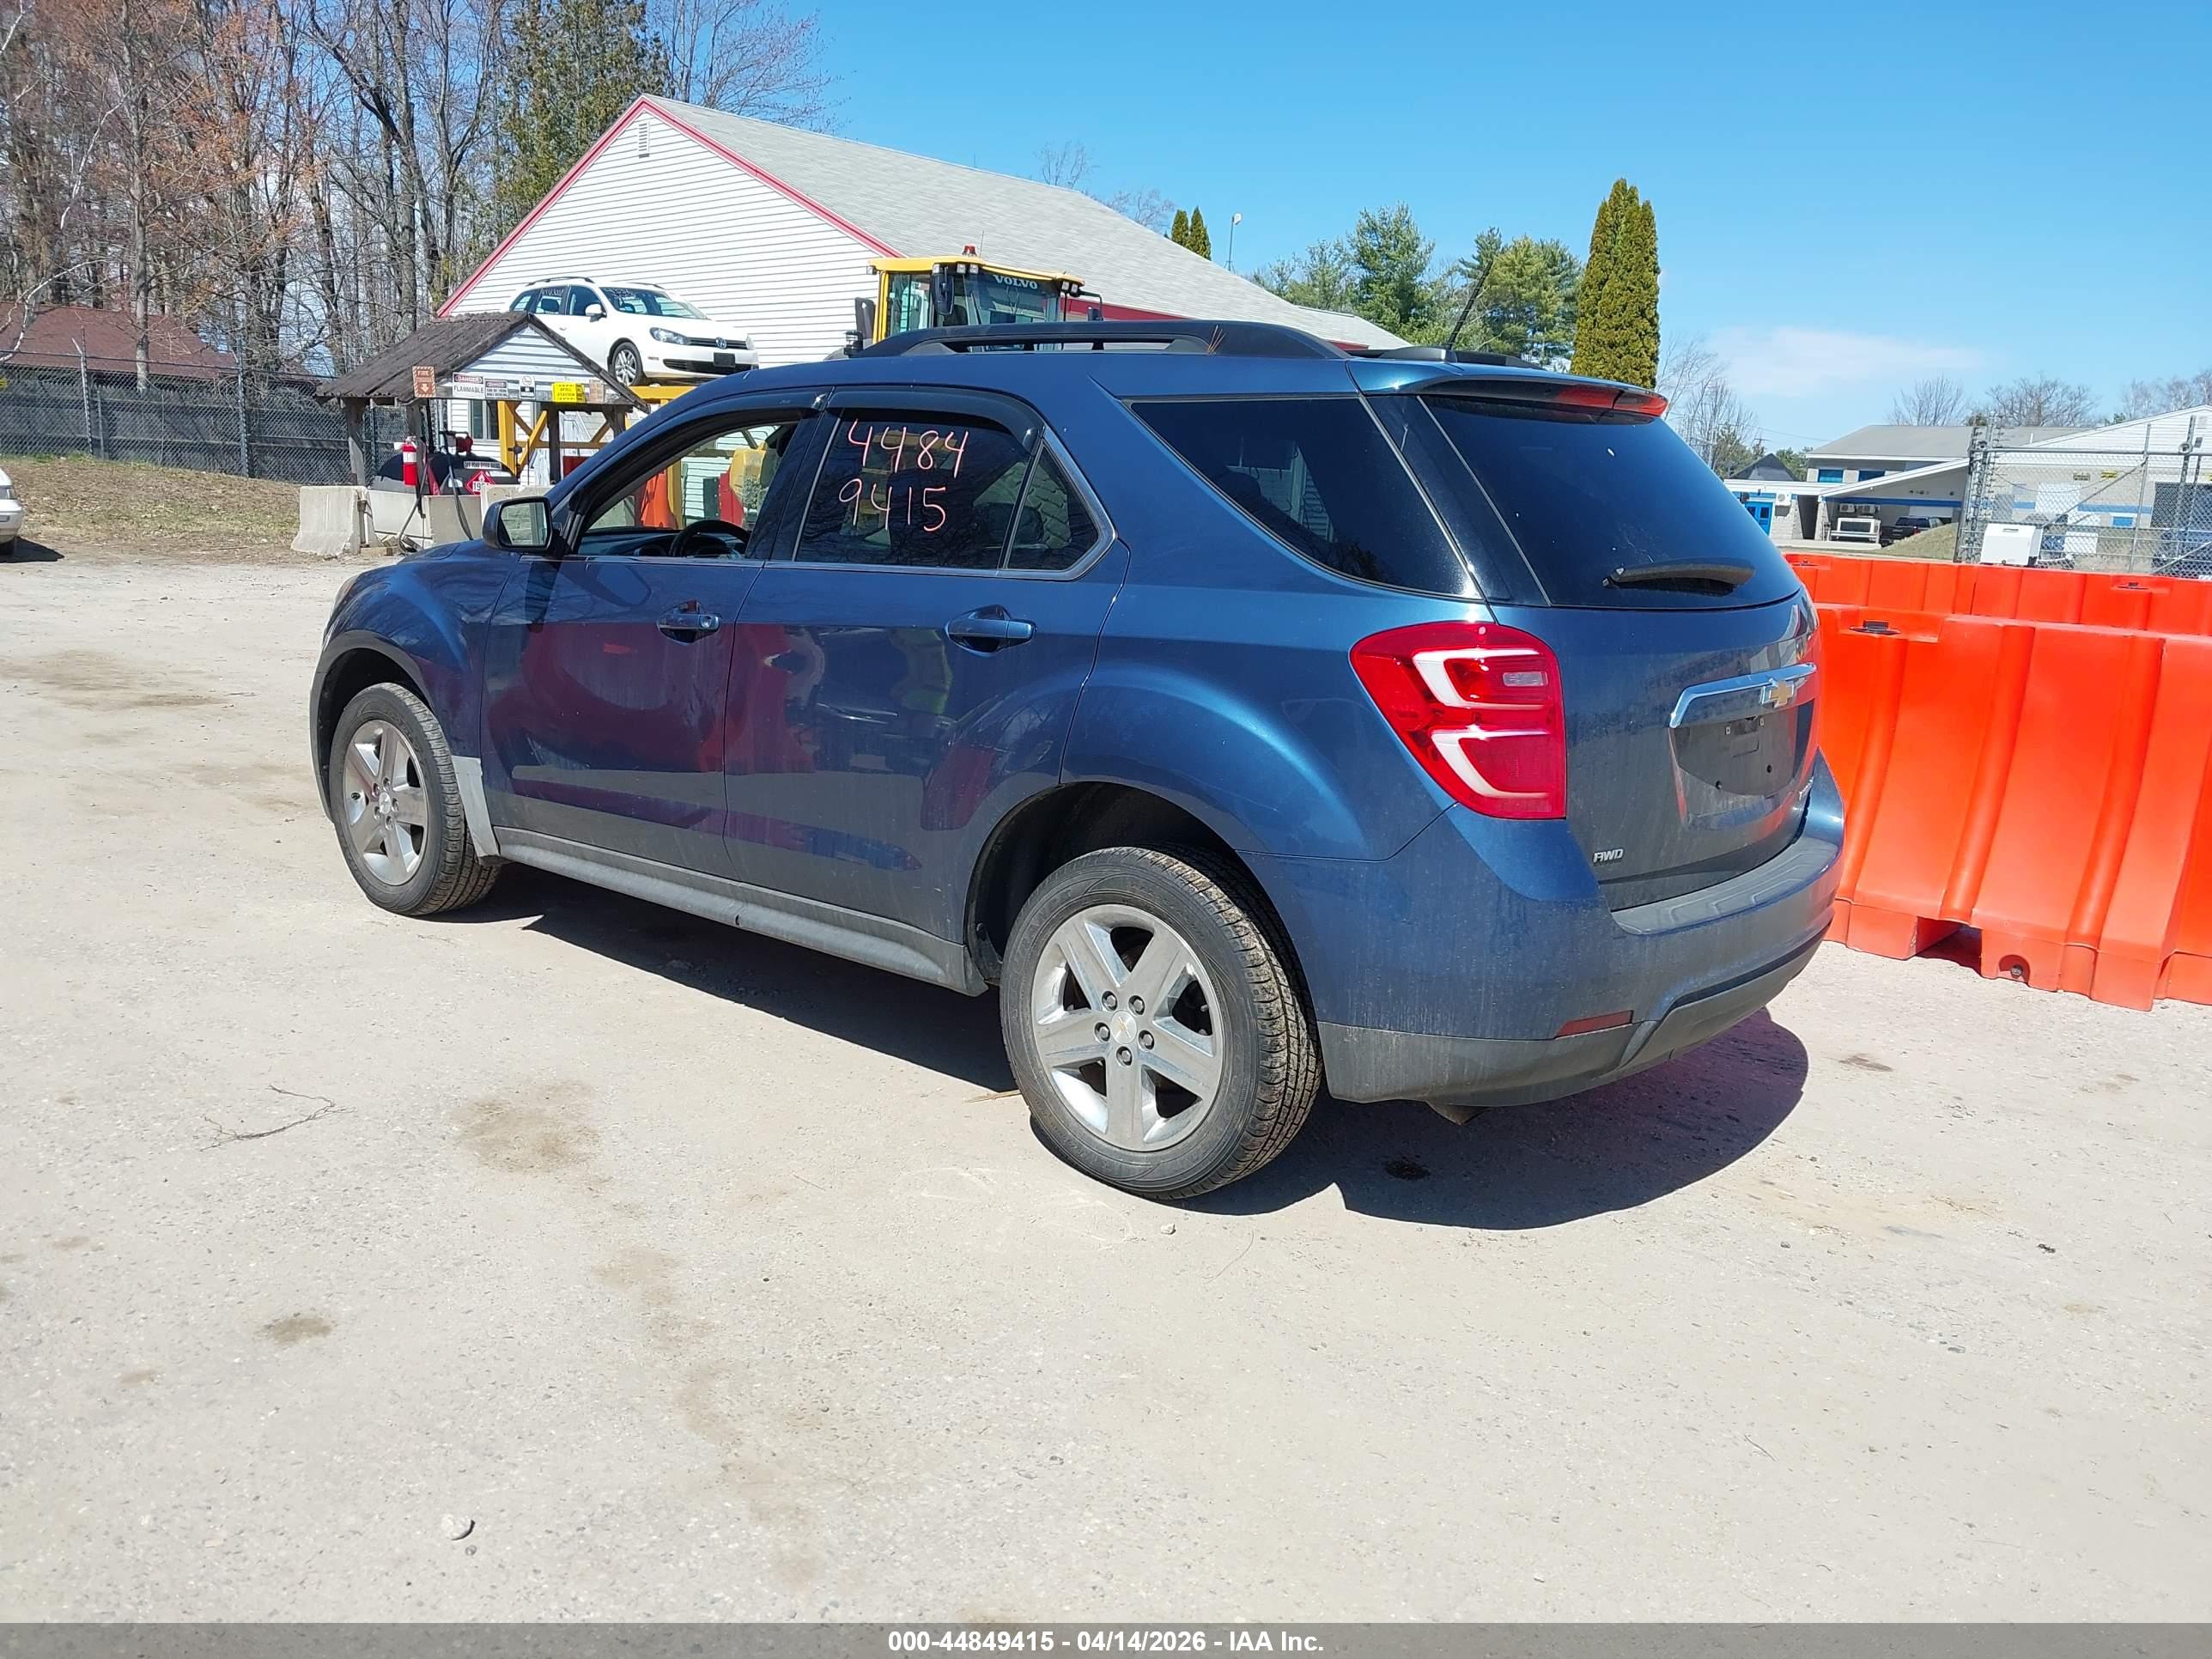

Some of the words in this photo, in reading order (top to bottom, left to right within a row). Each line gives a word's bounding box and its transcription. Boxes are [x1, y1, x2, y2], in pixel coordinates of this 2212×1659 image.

[993, 274, 1038, 289] VOLVO
[453, 385, 483, 393] FLAMMABLE
[847, 418, 969, 479] 4484
[839, 477, 947, 532] 9415
[1593, 848, 1624, 863] AWD
